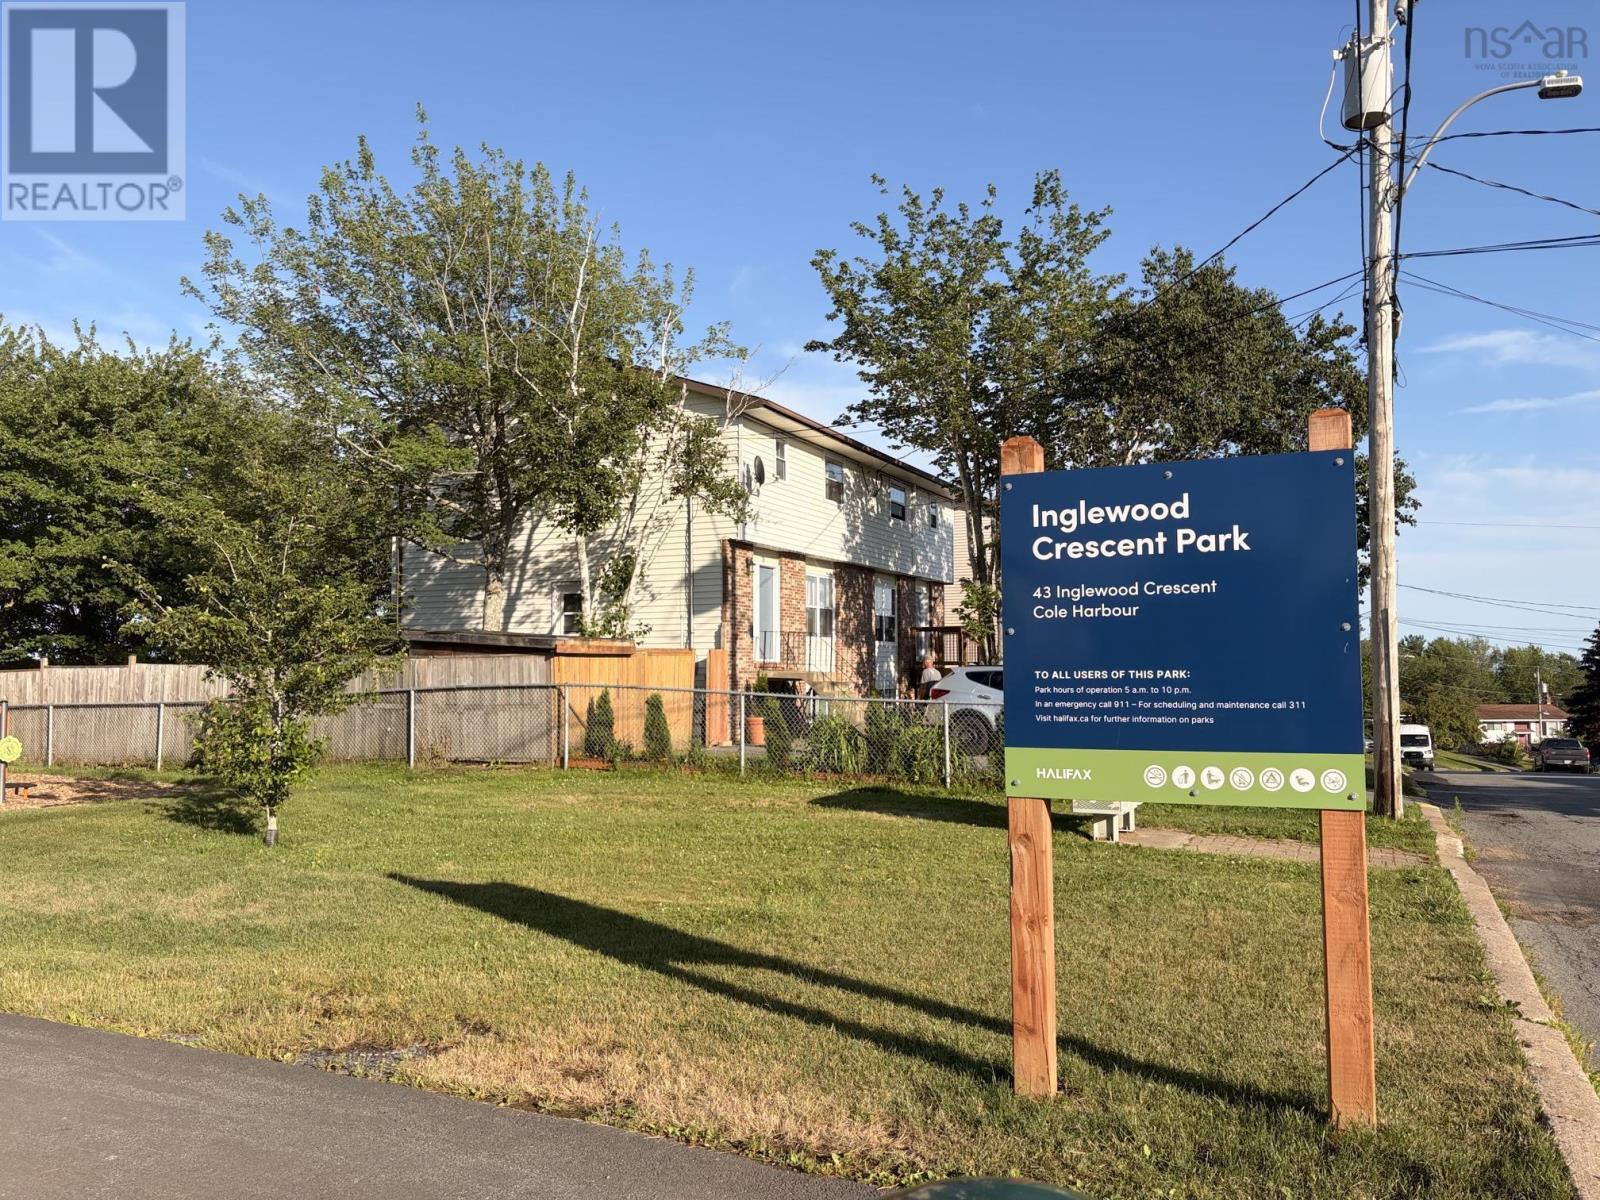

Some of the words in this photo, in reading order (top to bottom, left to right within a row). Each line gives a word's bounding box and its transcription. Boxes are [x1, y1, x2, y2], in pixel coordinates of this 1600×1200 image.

[1032, 492, 1190, 533] Inglewood
[1032, 531, 1167, 561] Crescent
[1176, 524, 1251, 554] Park
[1032, 586, 1051, 599] 43
[1056, 581, 1139, 601] Inglewood
[1143, 579, 1218, 596] Crescent
[1033, 605, 1068, 619] Cole
[1072, 603, 1140, 618] Harbour
[1034, 670, 1049, 679] TO
[1051, 670, 1072, 679] ALL
[1073, 670, 1109, 679] USERS
[1110, 670, 1126, 679] OF
[1128, 670, 1154, 679] THIS
[1156, 669, 1191, 679] PARK:
[1034, 686, 1052, 694] Park
[1053, 686, 1075, 694] hours
[1075, 686, 1084, 694] of
[1085, 686, 1123, 695] operation
[1124, 686, 1130, 694] 5
[1131, 686, 1149, 694] a.m.
[1150, 686, 1160, 694] to
[1162, 686, 1173, 694] 10
[1174, 686, 1192, 695] p.m.
[1034, 700, 1043, 708] In
[1054, 701, 1097, 710] emergency
[1098, 700, 1112, 708] call
[1113, 700, 1129, 708] 911
[1138, 700, 1152, 708] For
[1153, 700, 1197, 710] scheduling
[1198, 701, 1215, 709] and
[1216, 700, 1270, 709] maintenance
[1271, 700, 1287, 709] call
[1288, 700, 1306, 709] 311
[1035, 714, 1052, 722] Visit
[1053, 714, 1089, 723] halifax.ca
[1090, 714, 1102, 722] for
[1103, 714, 1131, 723] further
[1131, 715, 1177, 723] information
[1191, 716, 1214, 725] parks
[1036, 767, 1092, 780] HALIFAX
